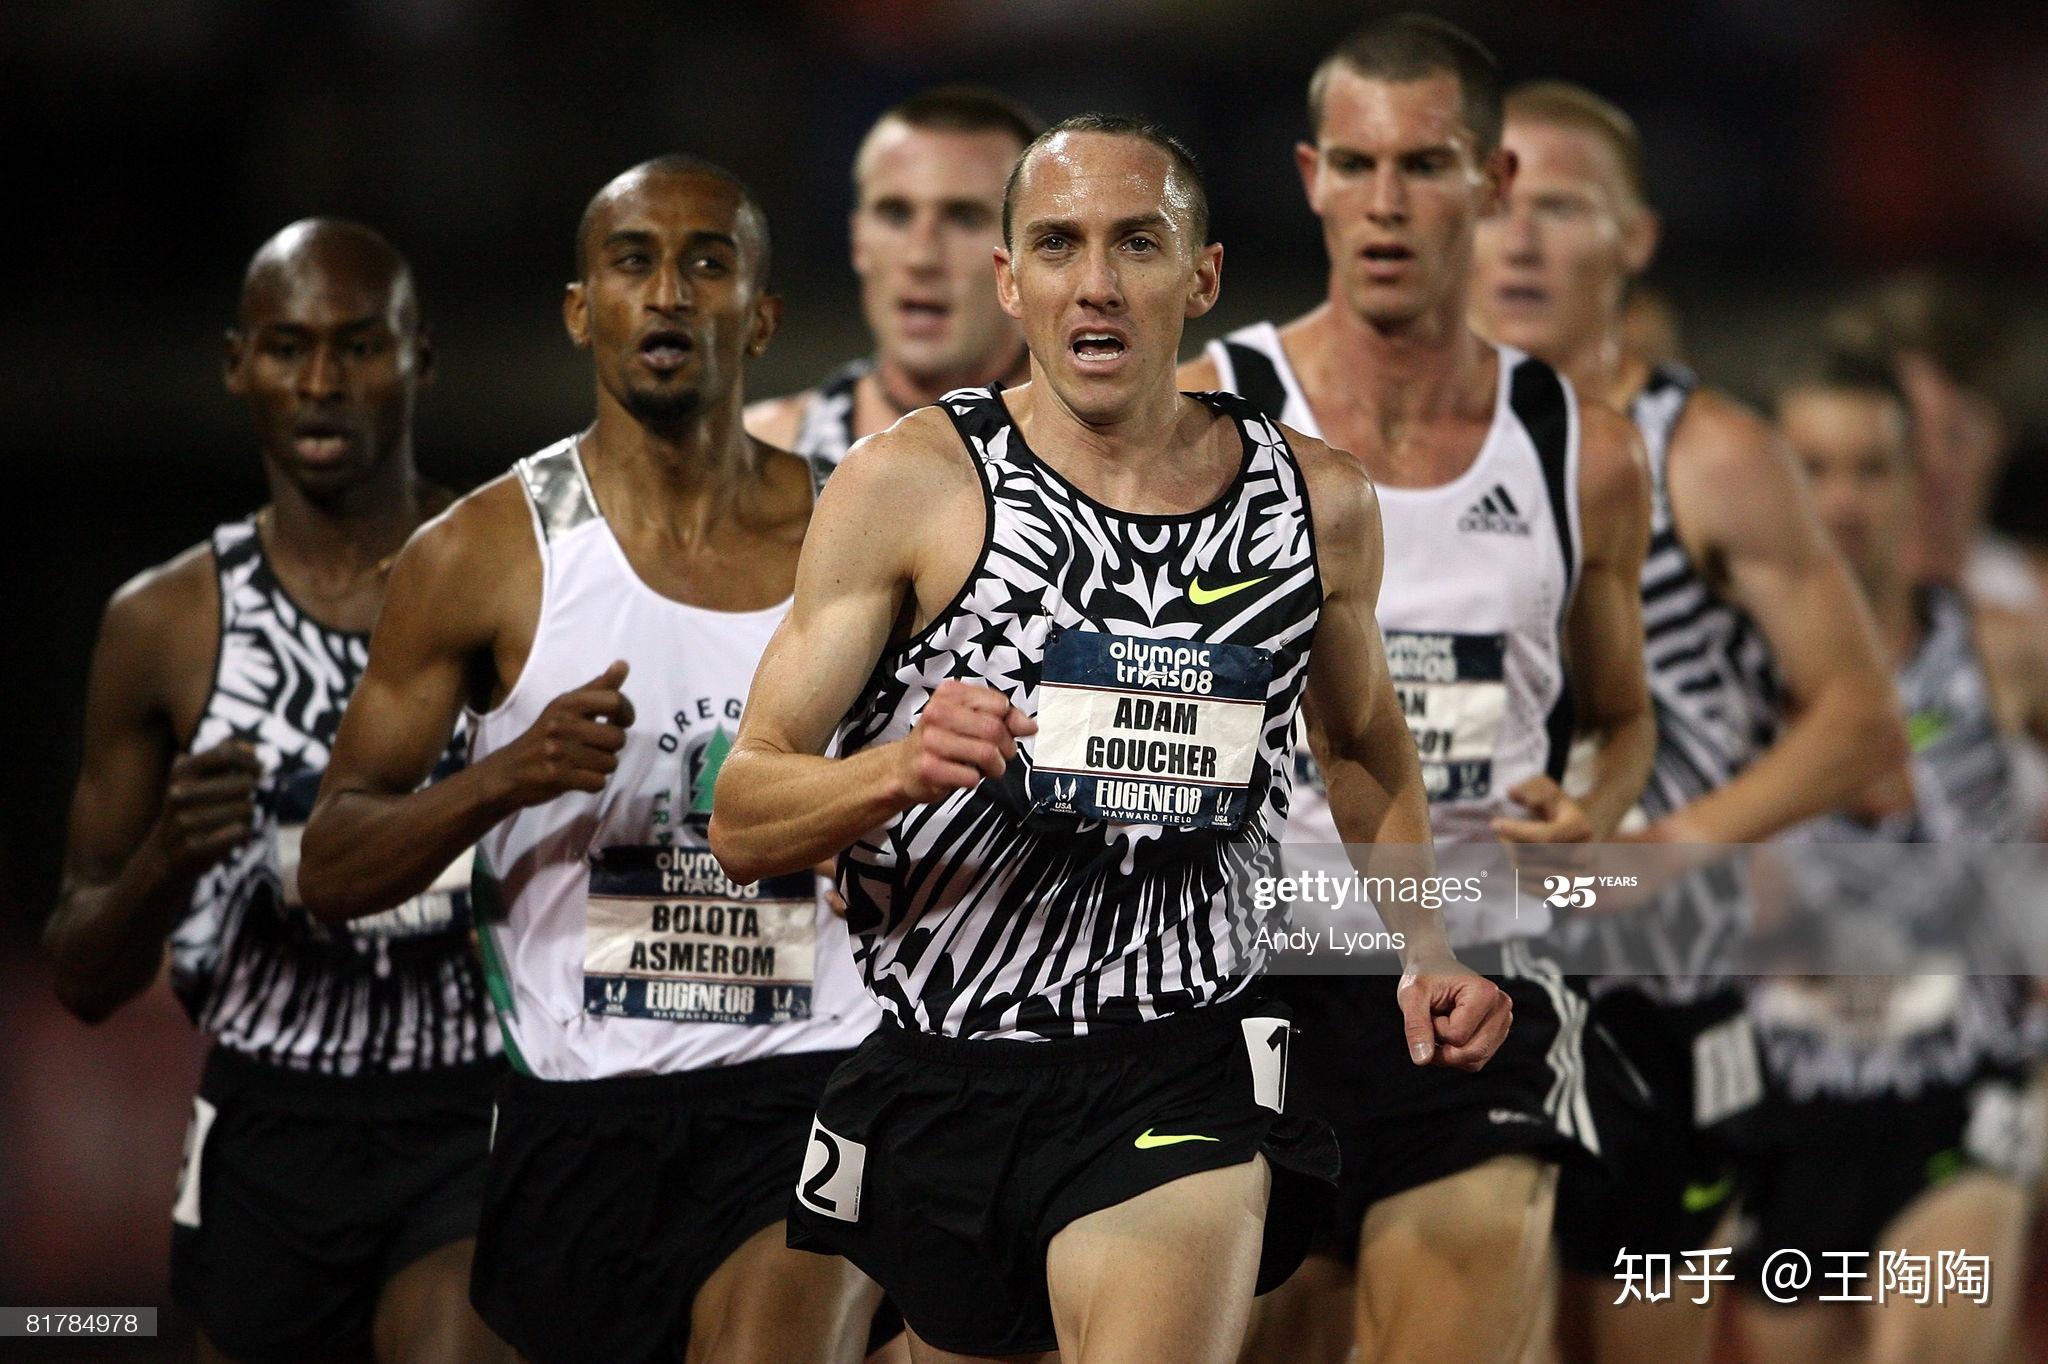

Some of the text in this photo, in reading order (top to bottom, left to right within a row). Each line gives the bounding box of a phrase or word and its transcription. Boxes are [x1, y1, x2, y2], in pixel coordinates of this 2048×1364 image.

[1109, 637, 1210, 672] olympic
[658, 698, 742, 753] OREG
[1113, 697, 1198, 735] ADAM
[1085, 736, 1217, 778] GOUCHER
[1095, 779, 1202, 815] EUGENE08
[1102, 809, 1192, 824] HAYWARD FIELD
[652, 904, 760, 938] BOLOTA
[629, 941, 775, 977] ASMEROM
[645, 981, 755, 1015] EUGENE08
[801, 1128, 840, 1213] 2
